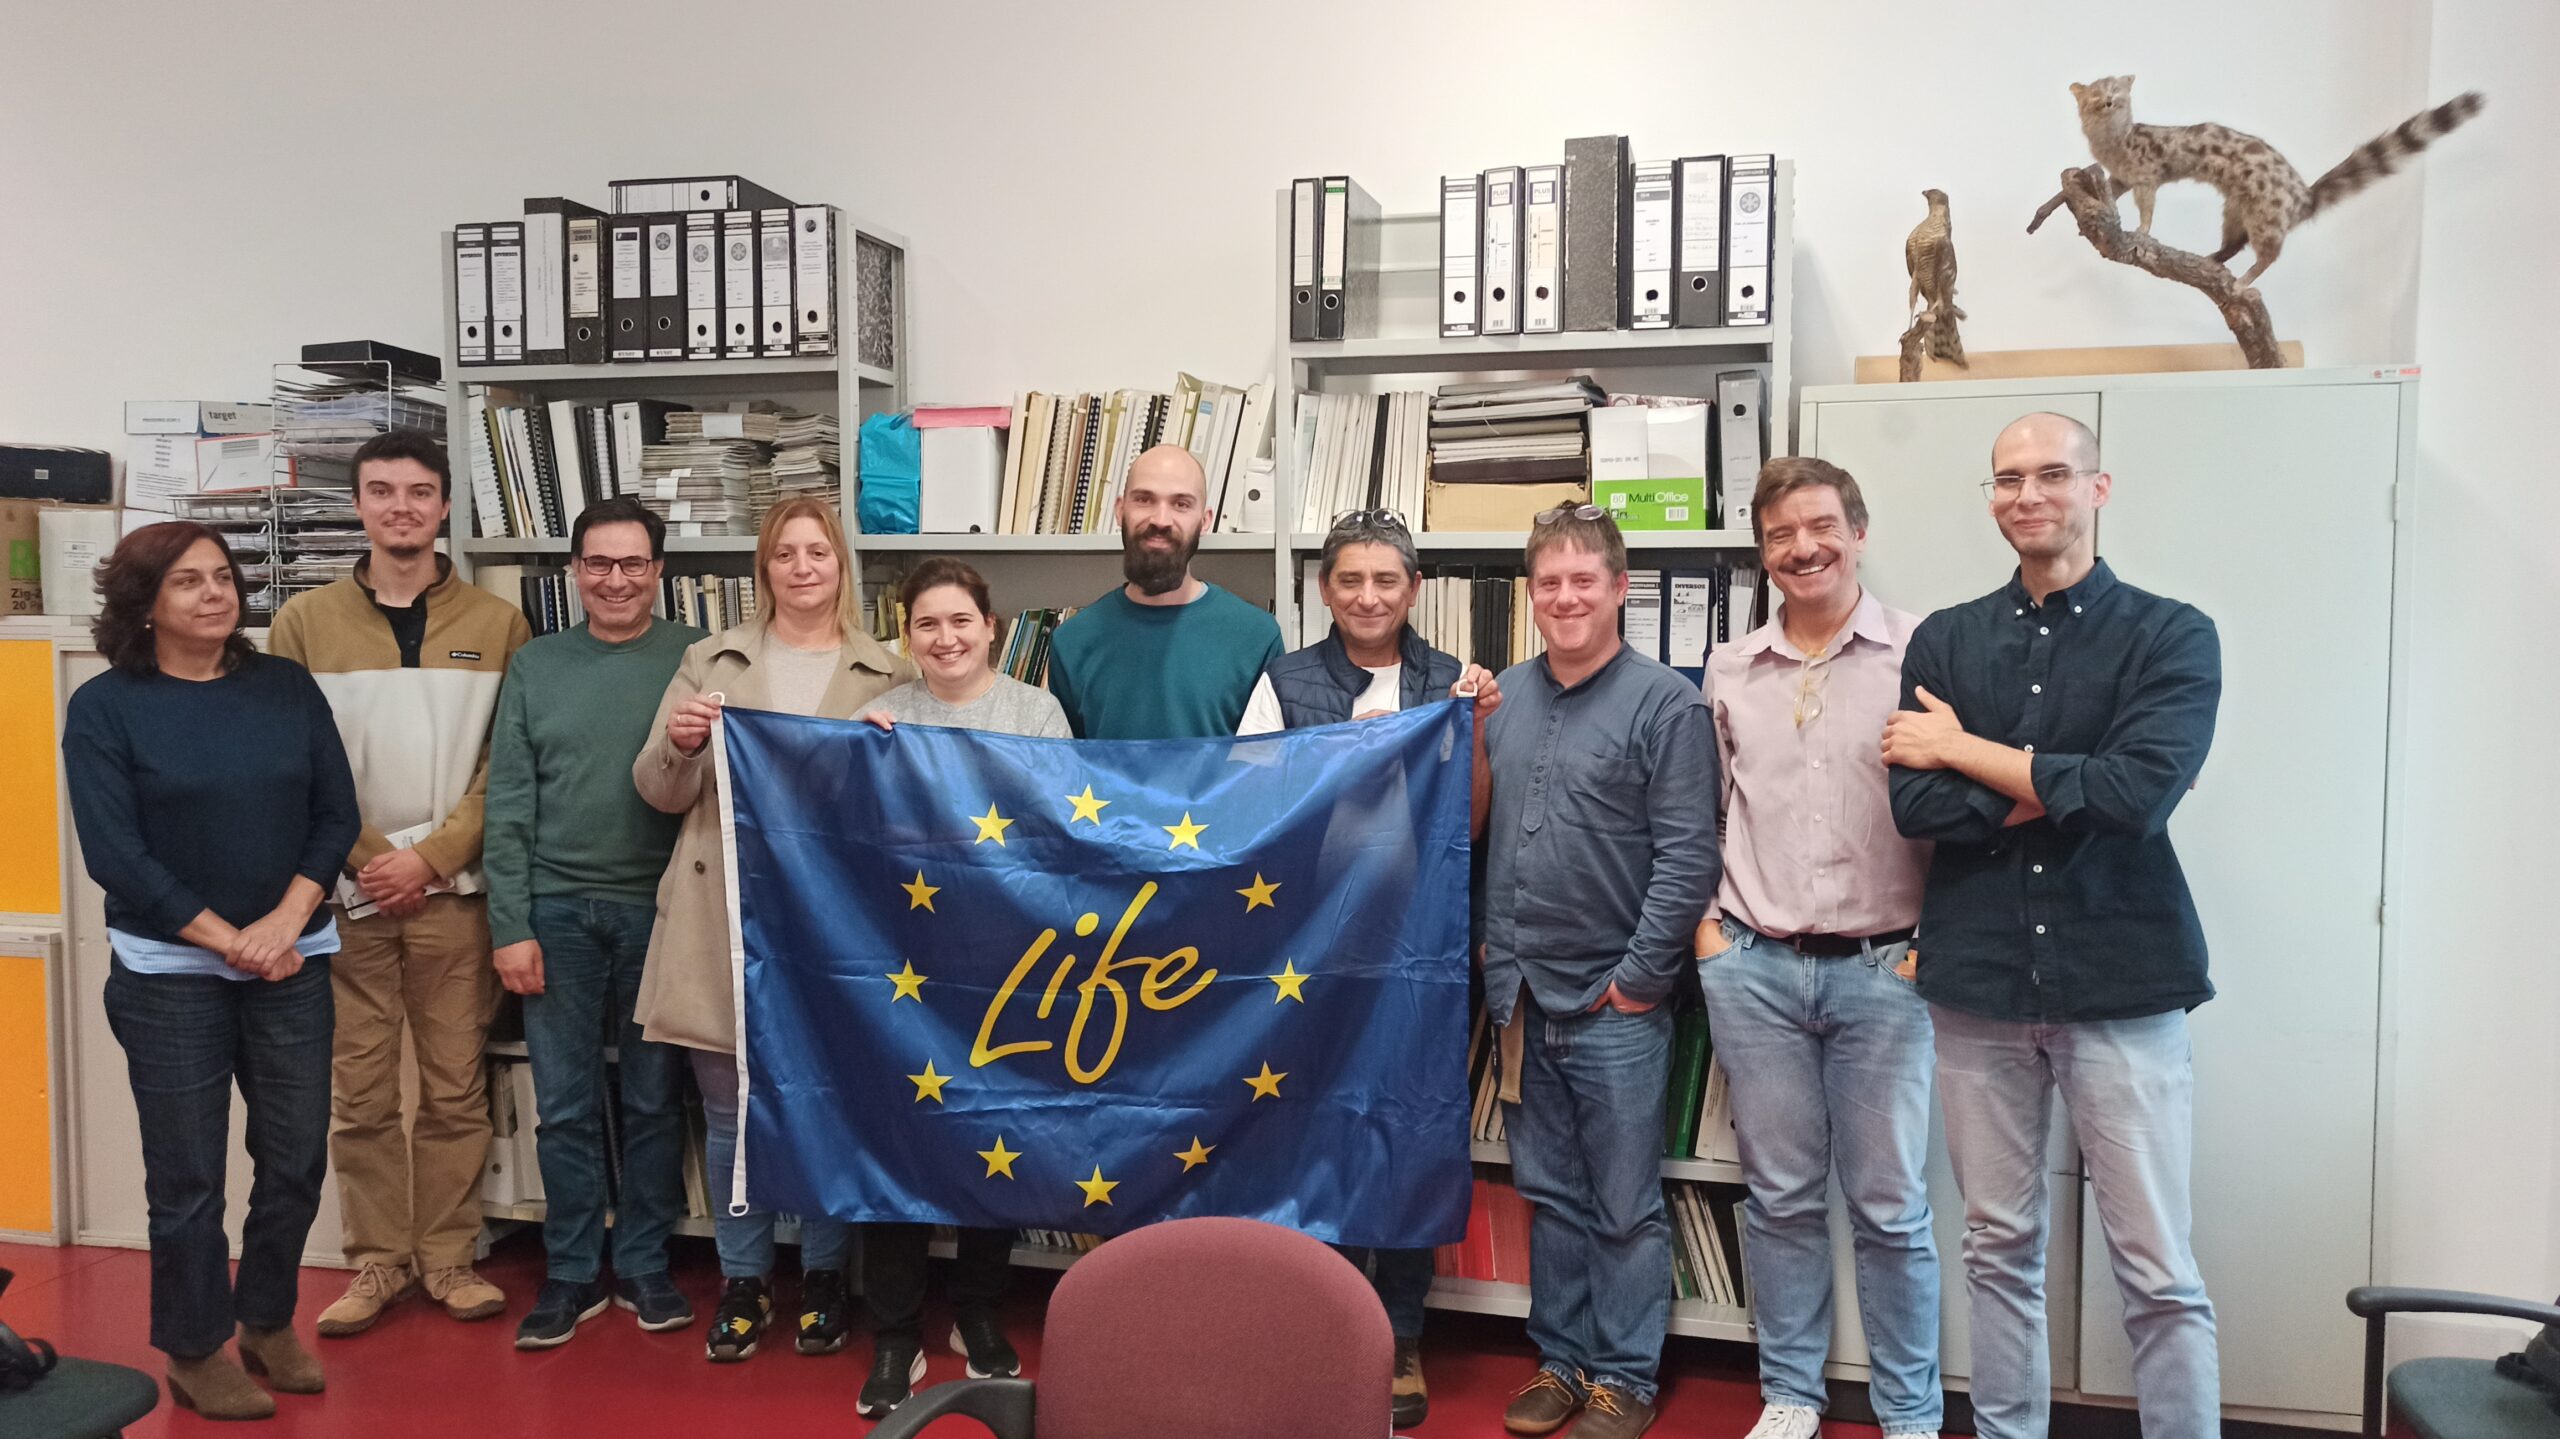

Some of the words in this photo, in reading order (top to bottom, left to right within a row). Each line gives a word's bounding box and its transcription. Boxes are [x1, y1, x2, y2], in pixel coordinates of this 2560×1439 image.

[1493, 189, 1509, 197] PLUS
[1534, 187, 1551, 195] PLUS
[208, 410, 237, 421] target
[1628, 491, 1689, 504] MultiOffice
[11, 588, 42, 601] Zig-Z
[12, 600, 27, 610] 20
[969, 881, 1218, 1084] Life
